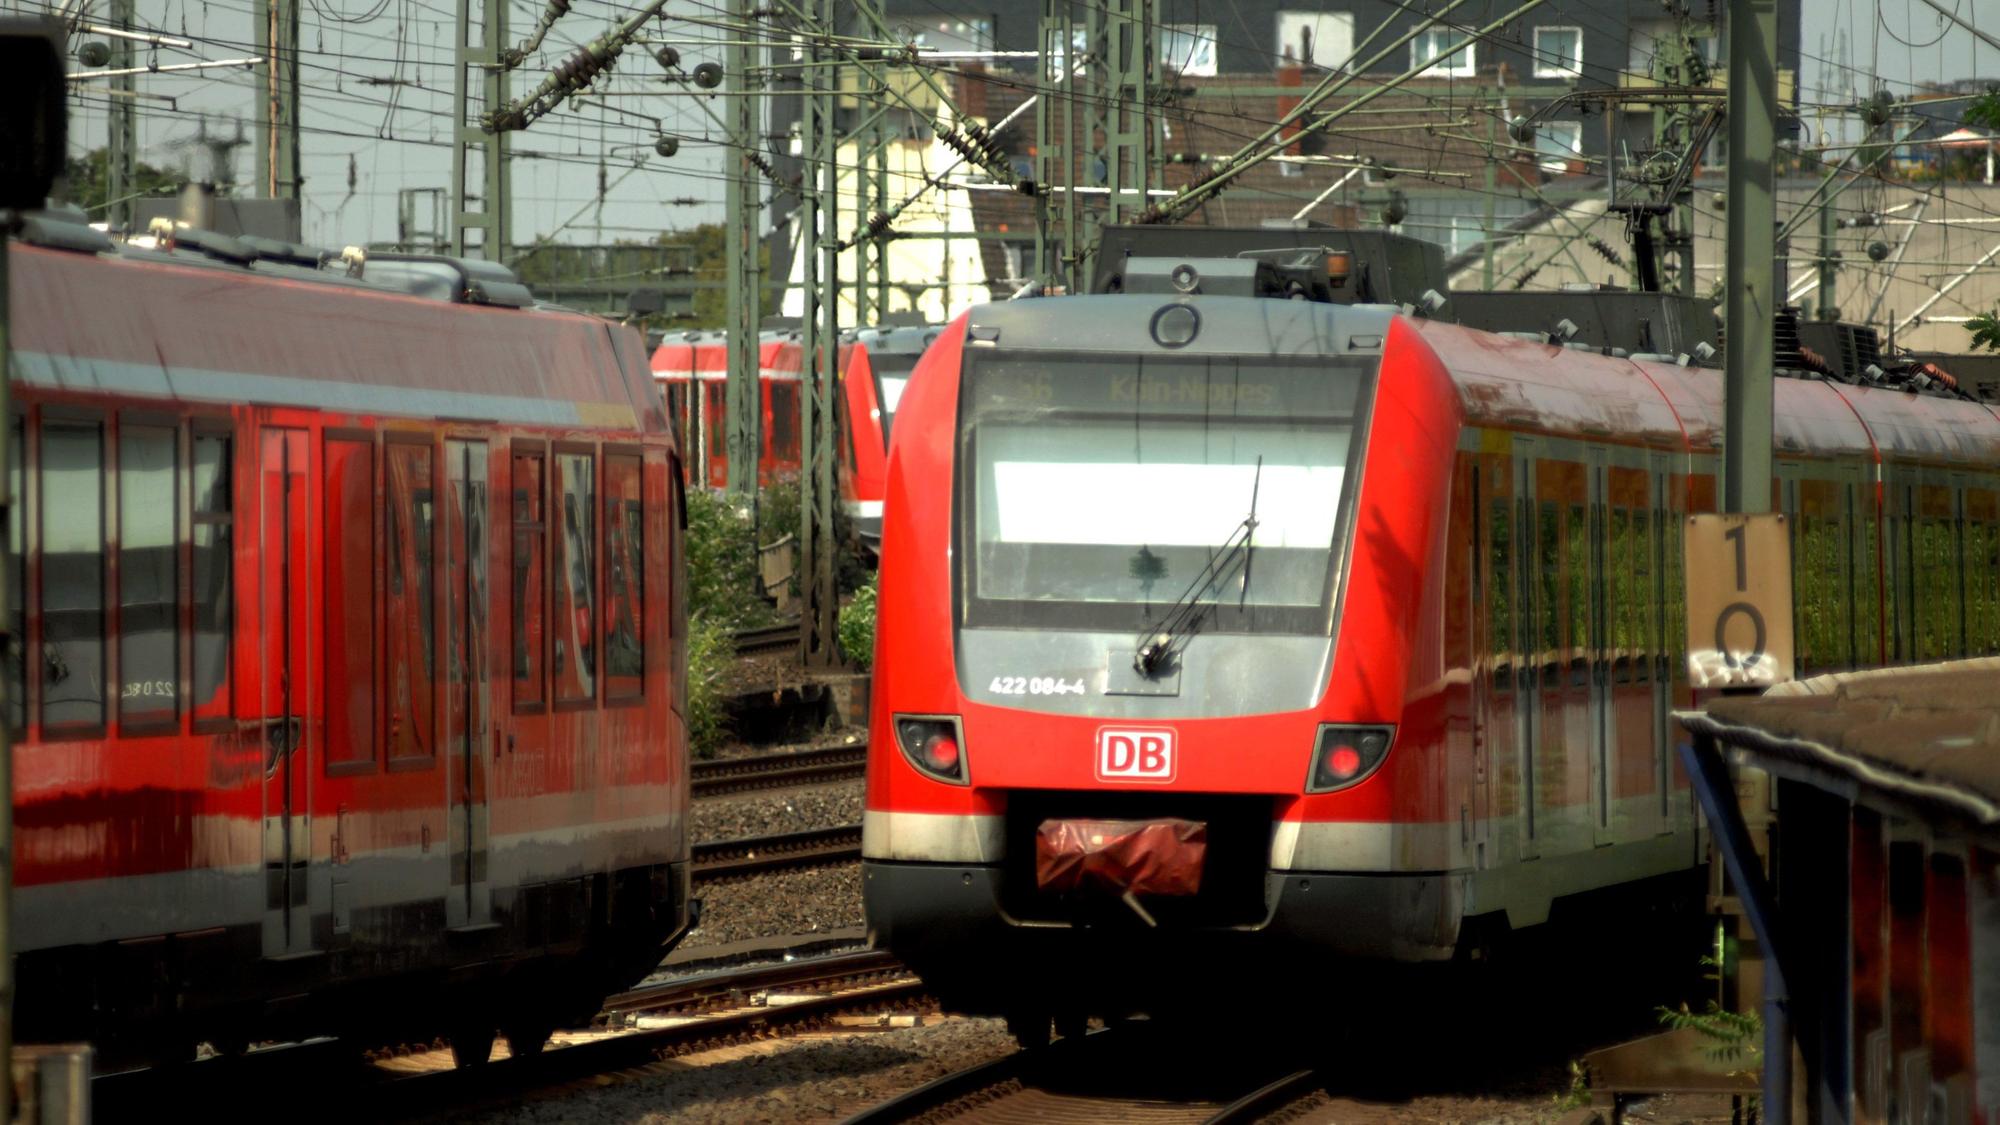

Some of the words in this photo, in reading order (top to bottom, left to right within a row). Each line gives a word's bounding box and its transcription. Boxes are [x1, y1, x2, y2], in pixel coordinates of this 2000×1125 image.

[1725, 524, 1747, 592] 1
[1715, 602, 1767, 669] 0
[989, 677, 1027, 694] 422
[1030, 677, 1085, 695] 084-4
[1107, 736, 1166, 773] DB
